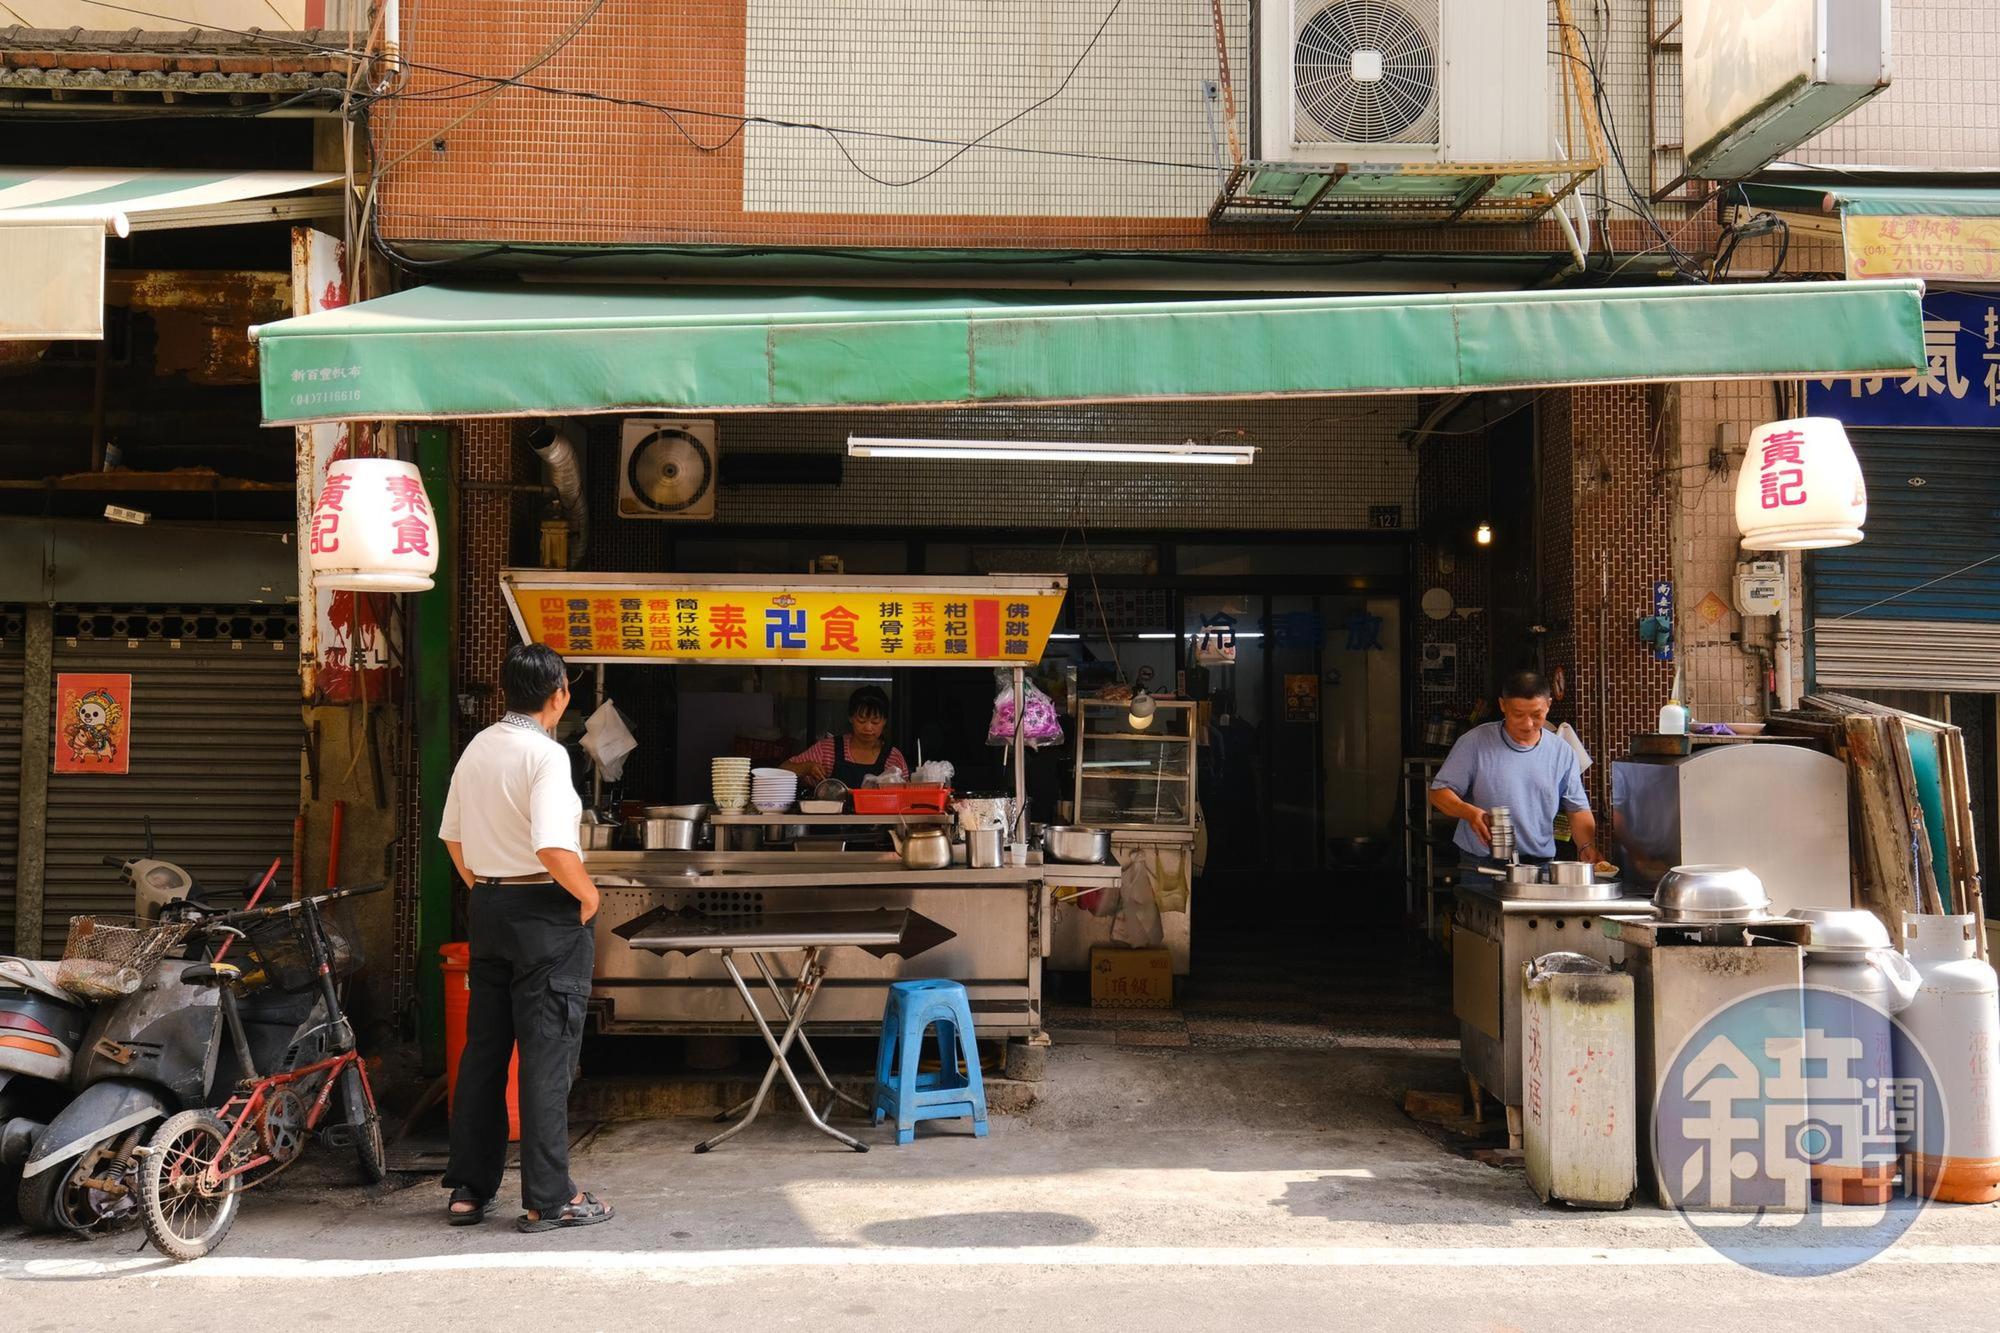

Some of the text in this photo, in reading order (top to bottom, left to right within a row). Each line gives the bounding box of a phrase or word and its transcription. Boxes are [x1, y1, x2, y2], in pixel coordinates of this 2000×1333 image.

[1820, 320, 1970, 399] 氣
[1760, 430, 1807, 509] 黃記
[385, 474, 430, 557] 素食
[1379, 514, 1398, 528] 127
[620, 599, 645, 650] 香菇白菜
[648, 599, 673, 651] 香菇苦瓜
[676, 599, 701, 650] 筒仔米糕
[880, 602, 903, 653] 排骨芋
[912, 602, 936, 654] 玉米香菇
